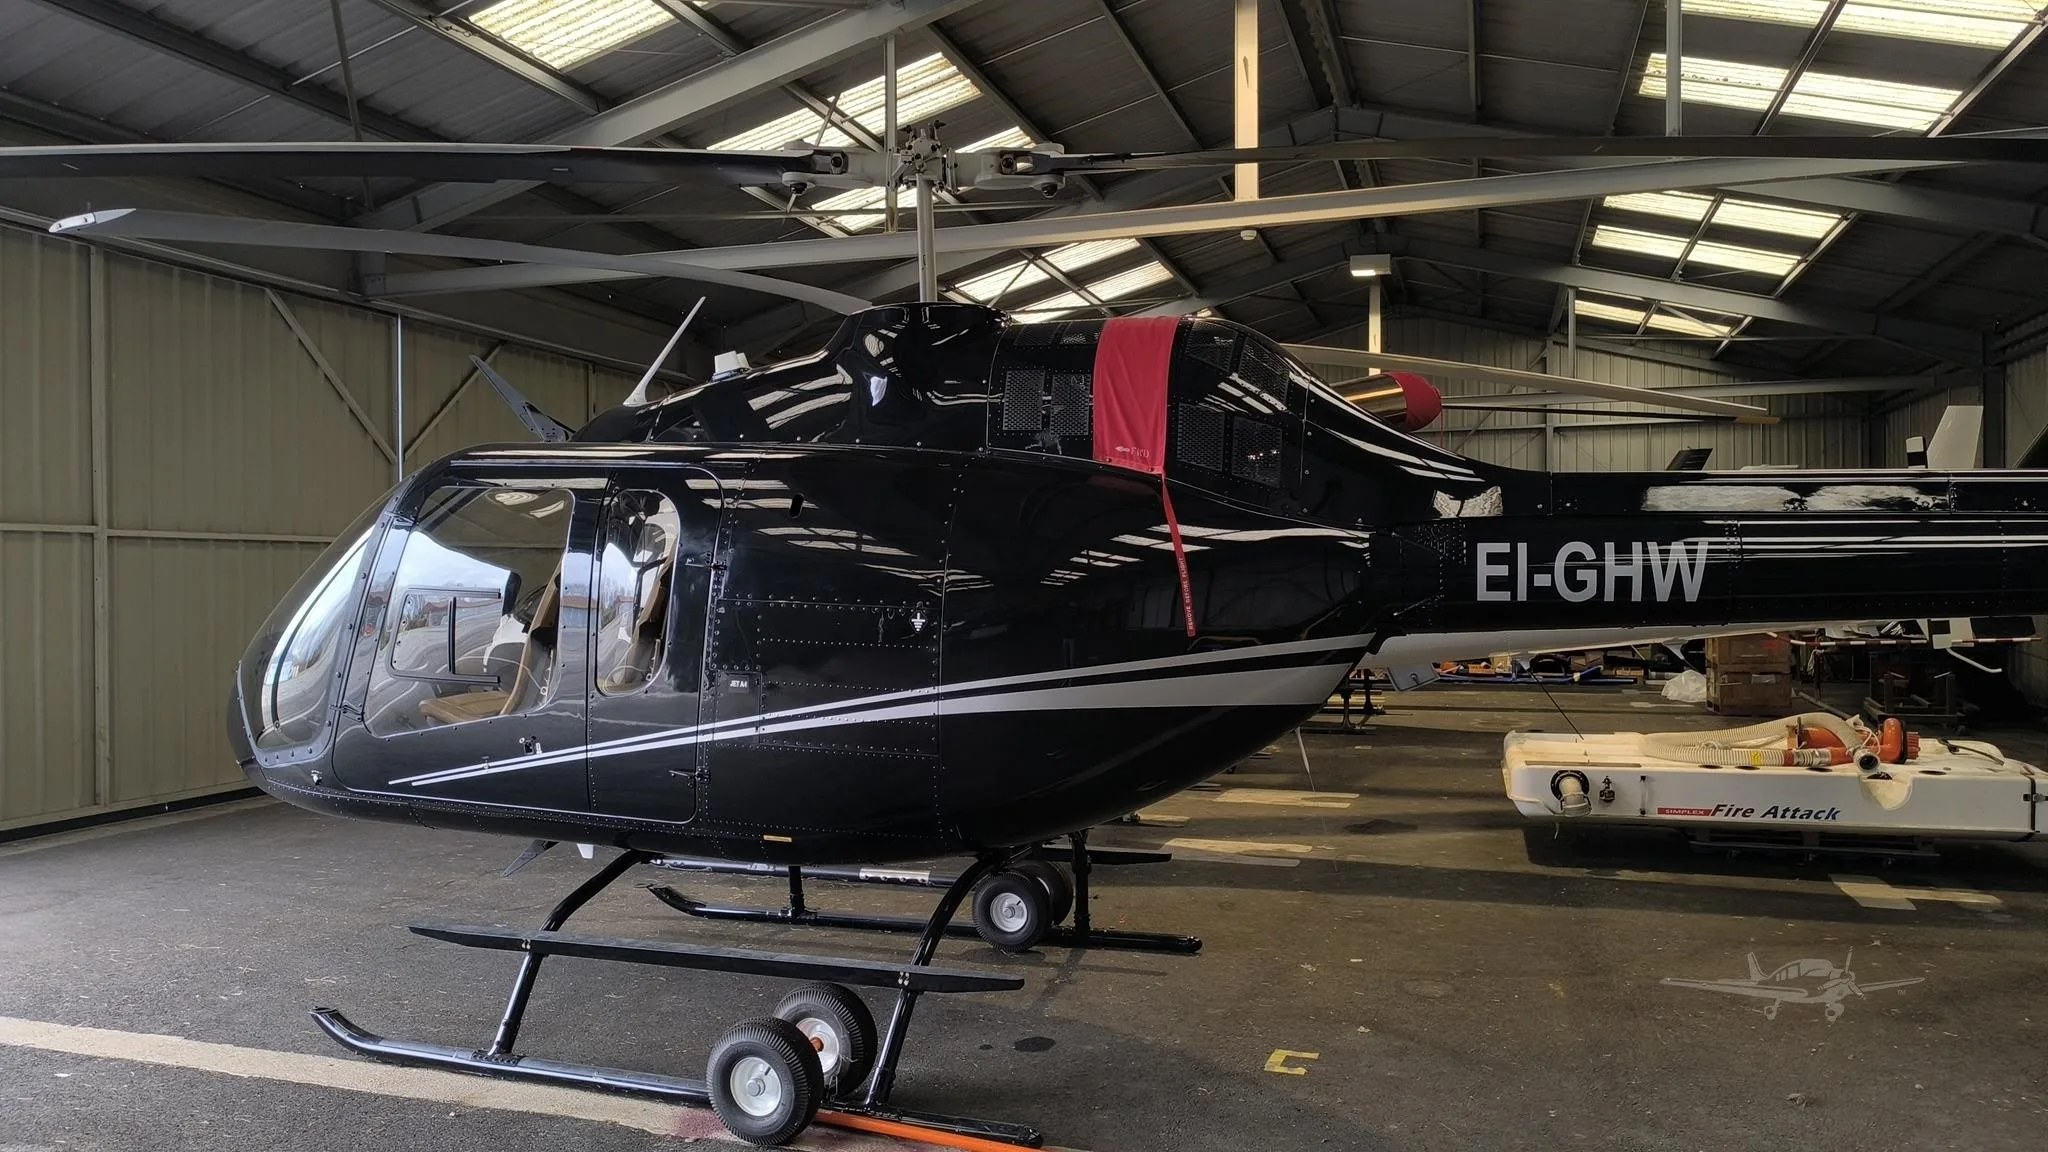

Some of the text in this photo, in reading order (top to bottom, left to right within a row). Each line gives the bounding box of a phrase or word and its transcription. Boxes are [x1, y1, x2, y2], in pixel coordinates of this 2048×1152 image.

[1178, 557, 1194, 630] REMOVE BEFORE FLIGHT
[1476, 541, 1709, 602] EI-GHW
[1710, 803, 1755, 818] Fire
[1760, 805, 1841, 821] Attack
